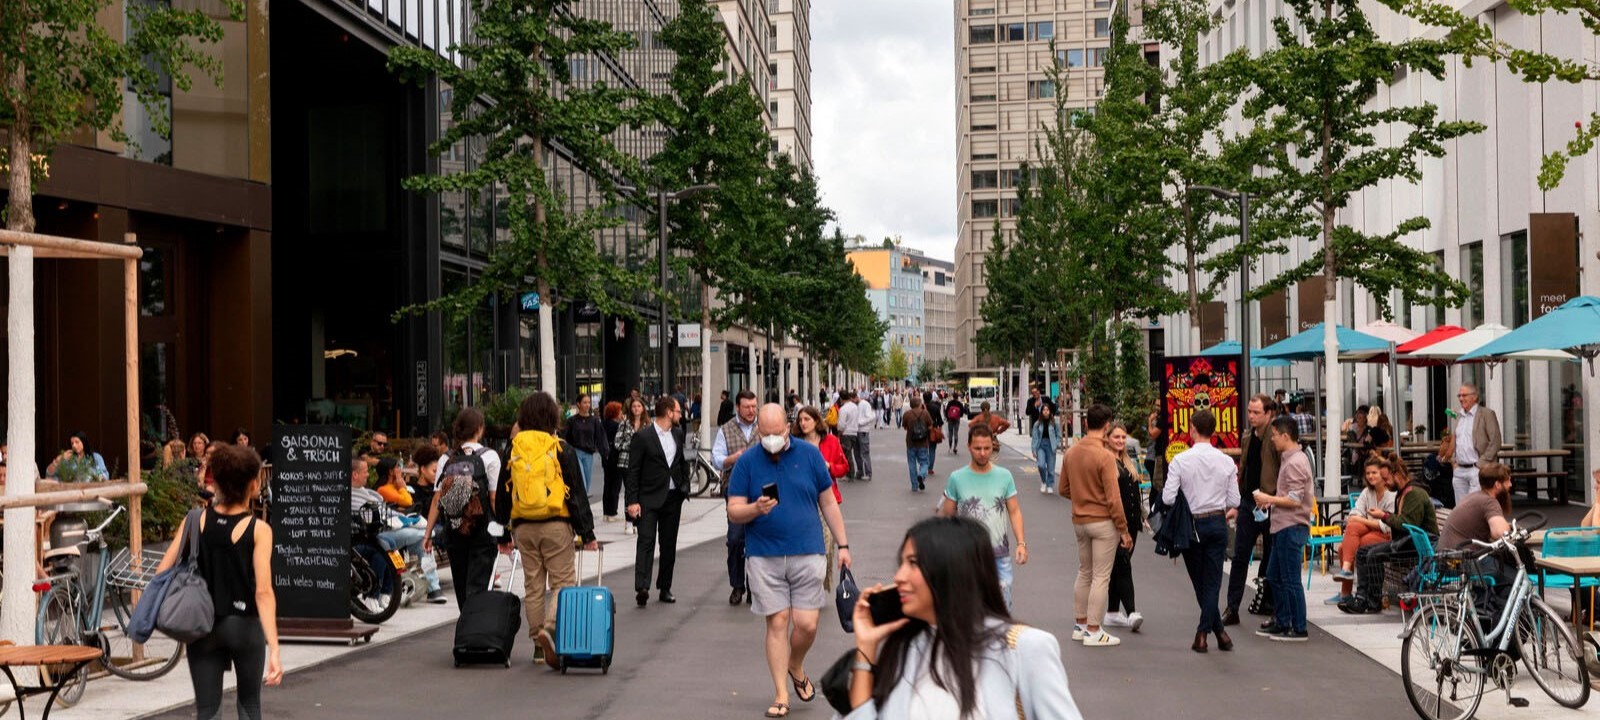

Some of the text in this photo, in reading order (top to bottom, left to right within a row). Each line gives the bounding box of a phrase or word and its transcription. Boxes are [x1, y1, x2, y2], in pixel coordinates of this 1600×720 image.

[1540, 294, 1567, 303] meet
[1540, 303, 1560, 314] foo
[1301, 320, 1320, 329] Goo
[280, 434, 343, 449] SAISONAL
[286, 447, 340, 463] & FRISCH
[320, 494, 341, 504] CURRY
[322, 516, 335, 526] EYE
[275, 574, 291, 587] Und
[293, 574, 314, 588] vieles
